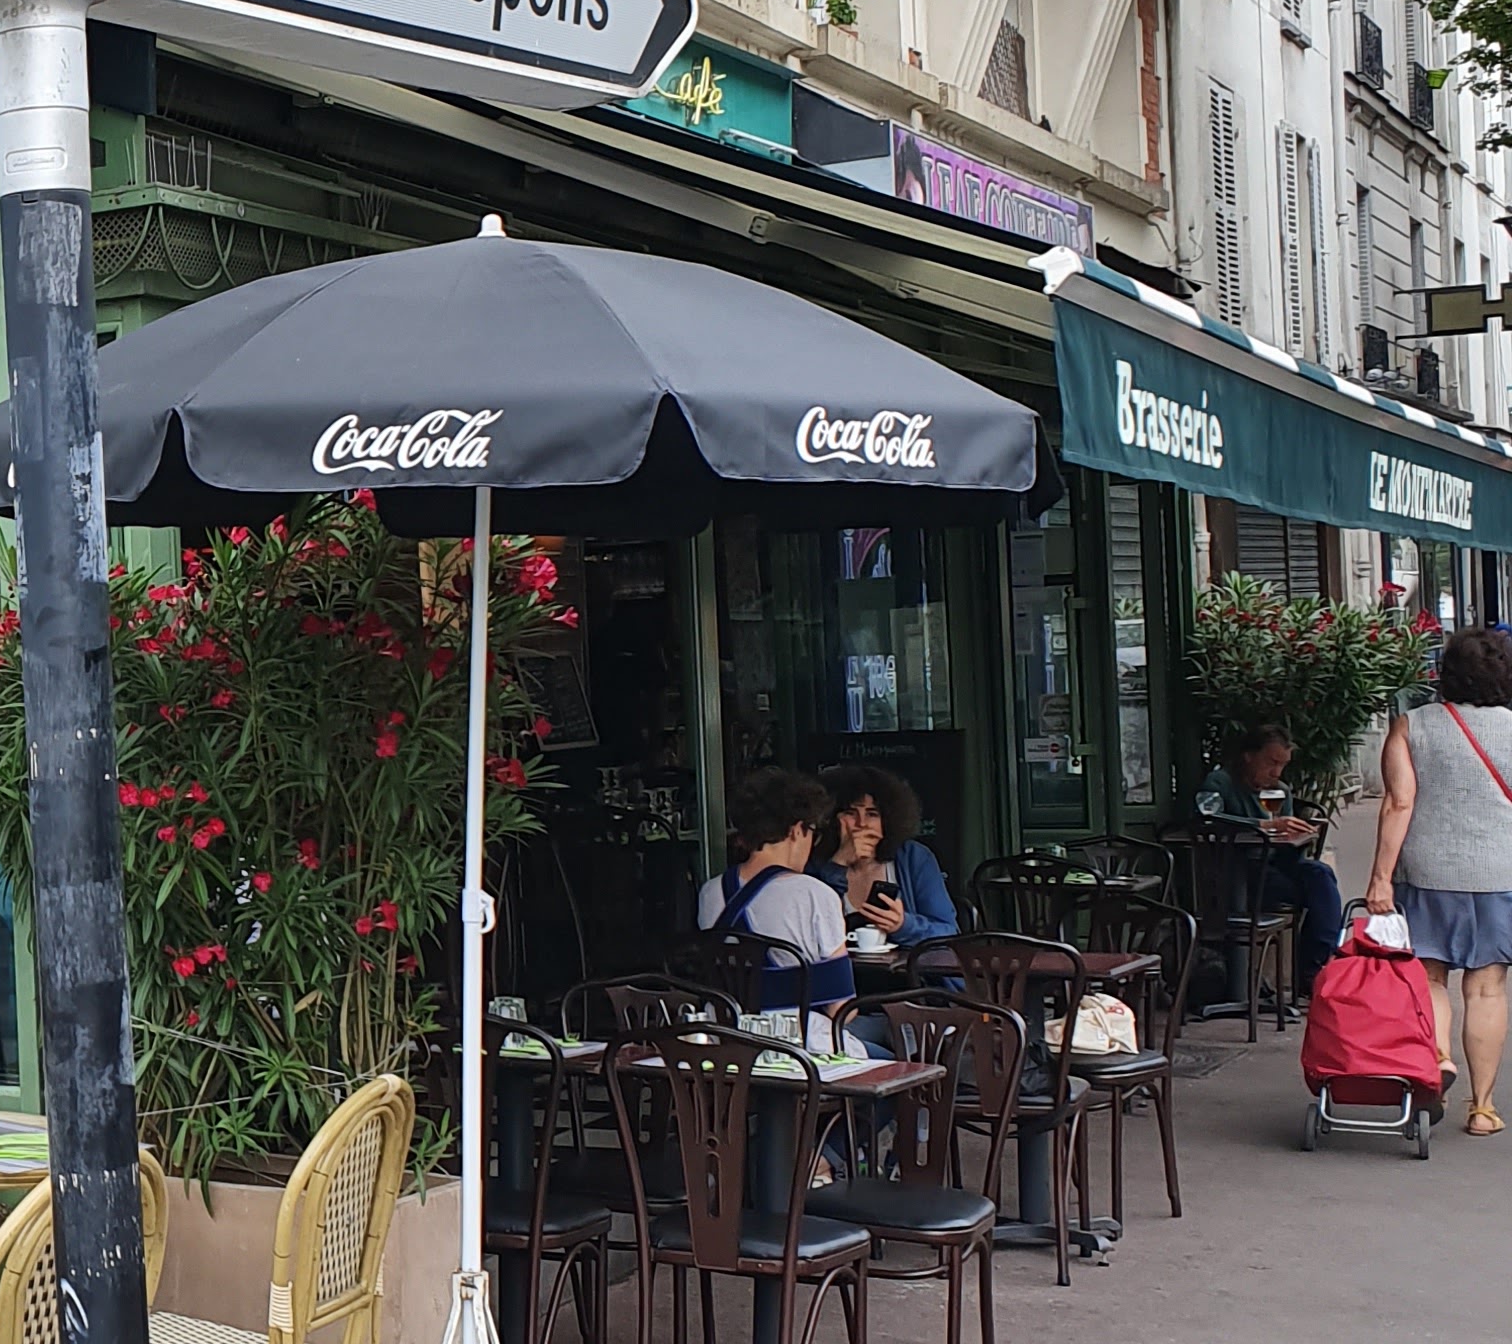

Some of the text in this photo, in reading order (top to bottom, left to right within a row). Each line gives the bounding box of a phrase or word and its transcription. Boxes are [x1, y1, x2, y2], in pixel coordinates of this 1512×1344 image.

[654, 56, 726, 124] afé
[312, 409, 504, 474] Coca-Cola
[796, 406, 936, 468] Coca-Cola
[1116, 359, 1224, 469] Brasserie
[1370, 450, 1472, 530] LE MONTMARTRE
